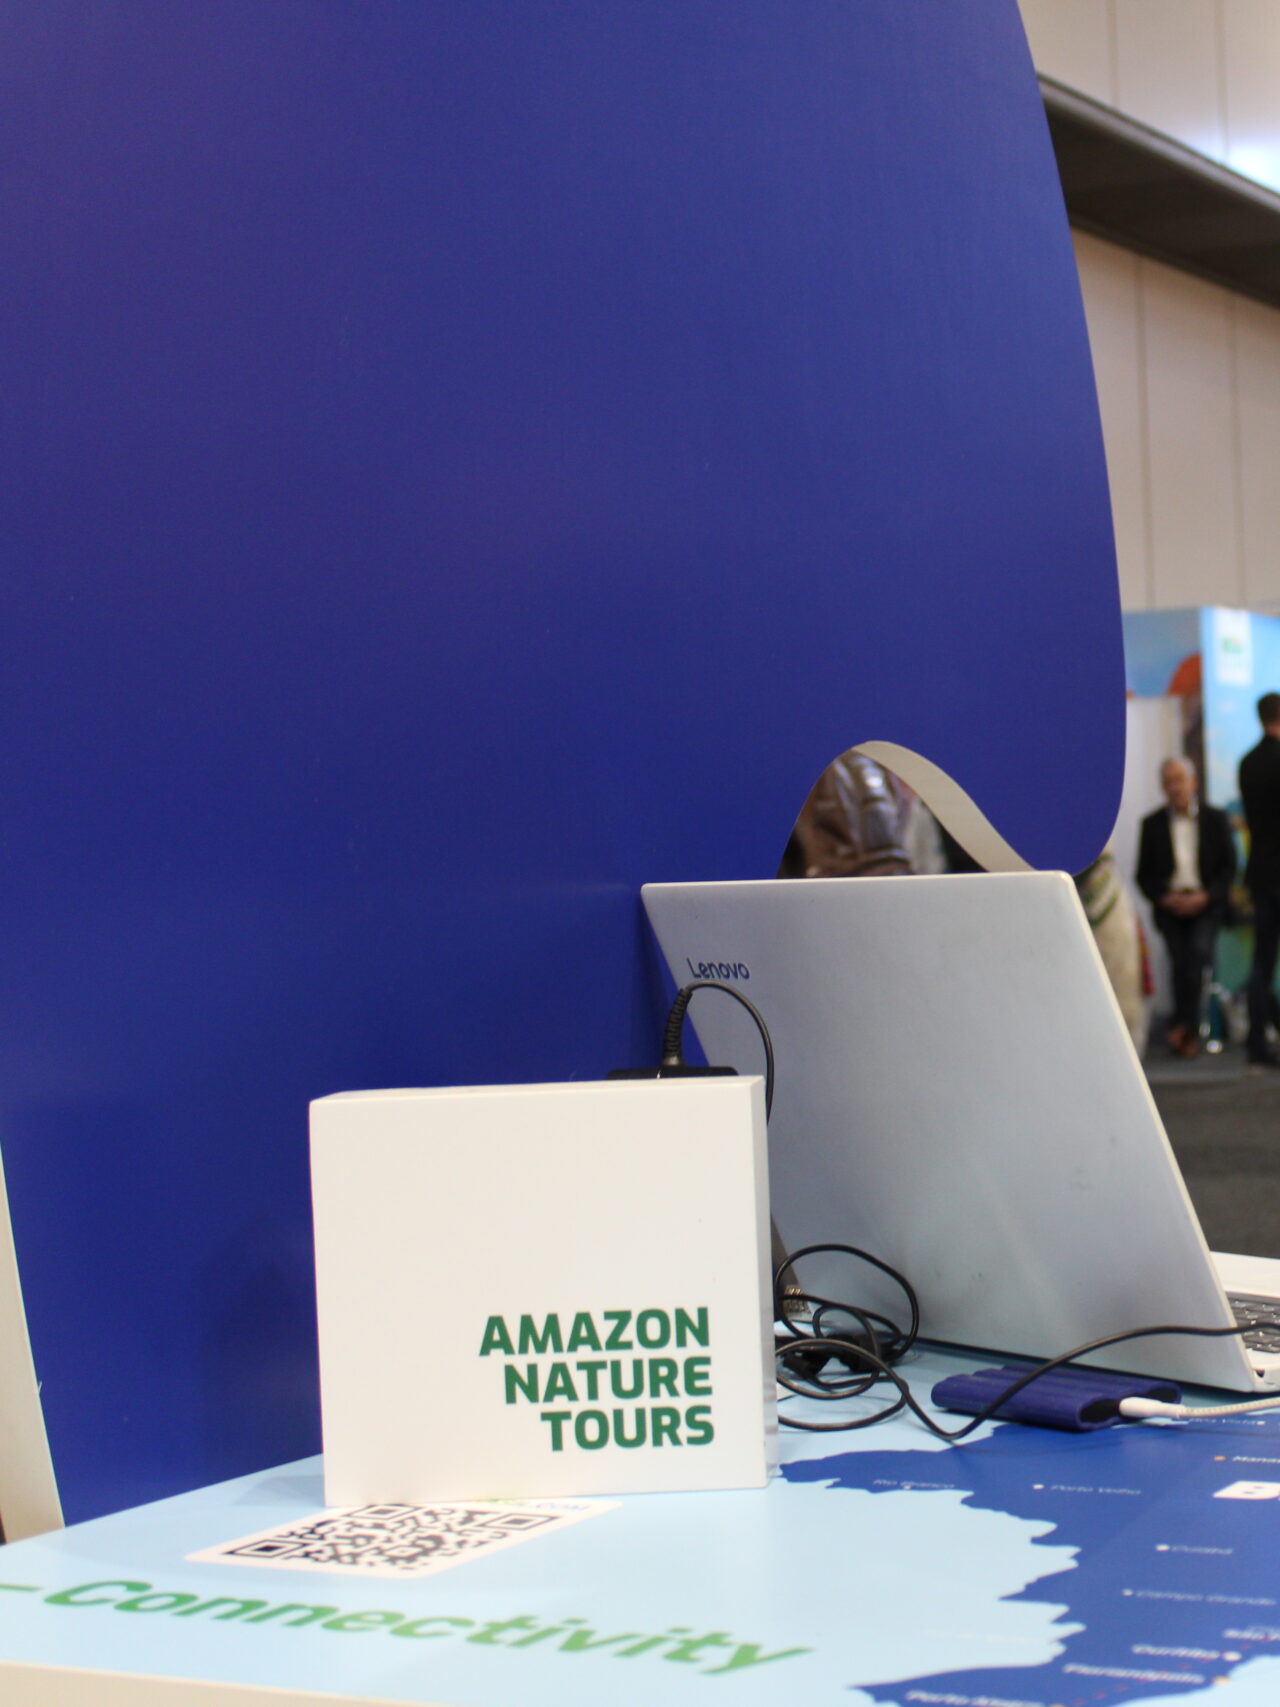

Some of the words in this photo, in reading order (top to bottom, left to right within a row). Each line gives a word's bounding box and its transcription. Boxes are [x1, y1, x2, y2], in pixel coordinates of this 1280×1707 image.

[686, 957, 750, 979] Lenovo
[479, 1306, 710, 1357] AMAZON
[504, 1356, 713, 1405] NATURE
[540, 1405, 715, 1452] TOURS
[42, 1579, 815, 1676] Connectivity
